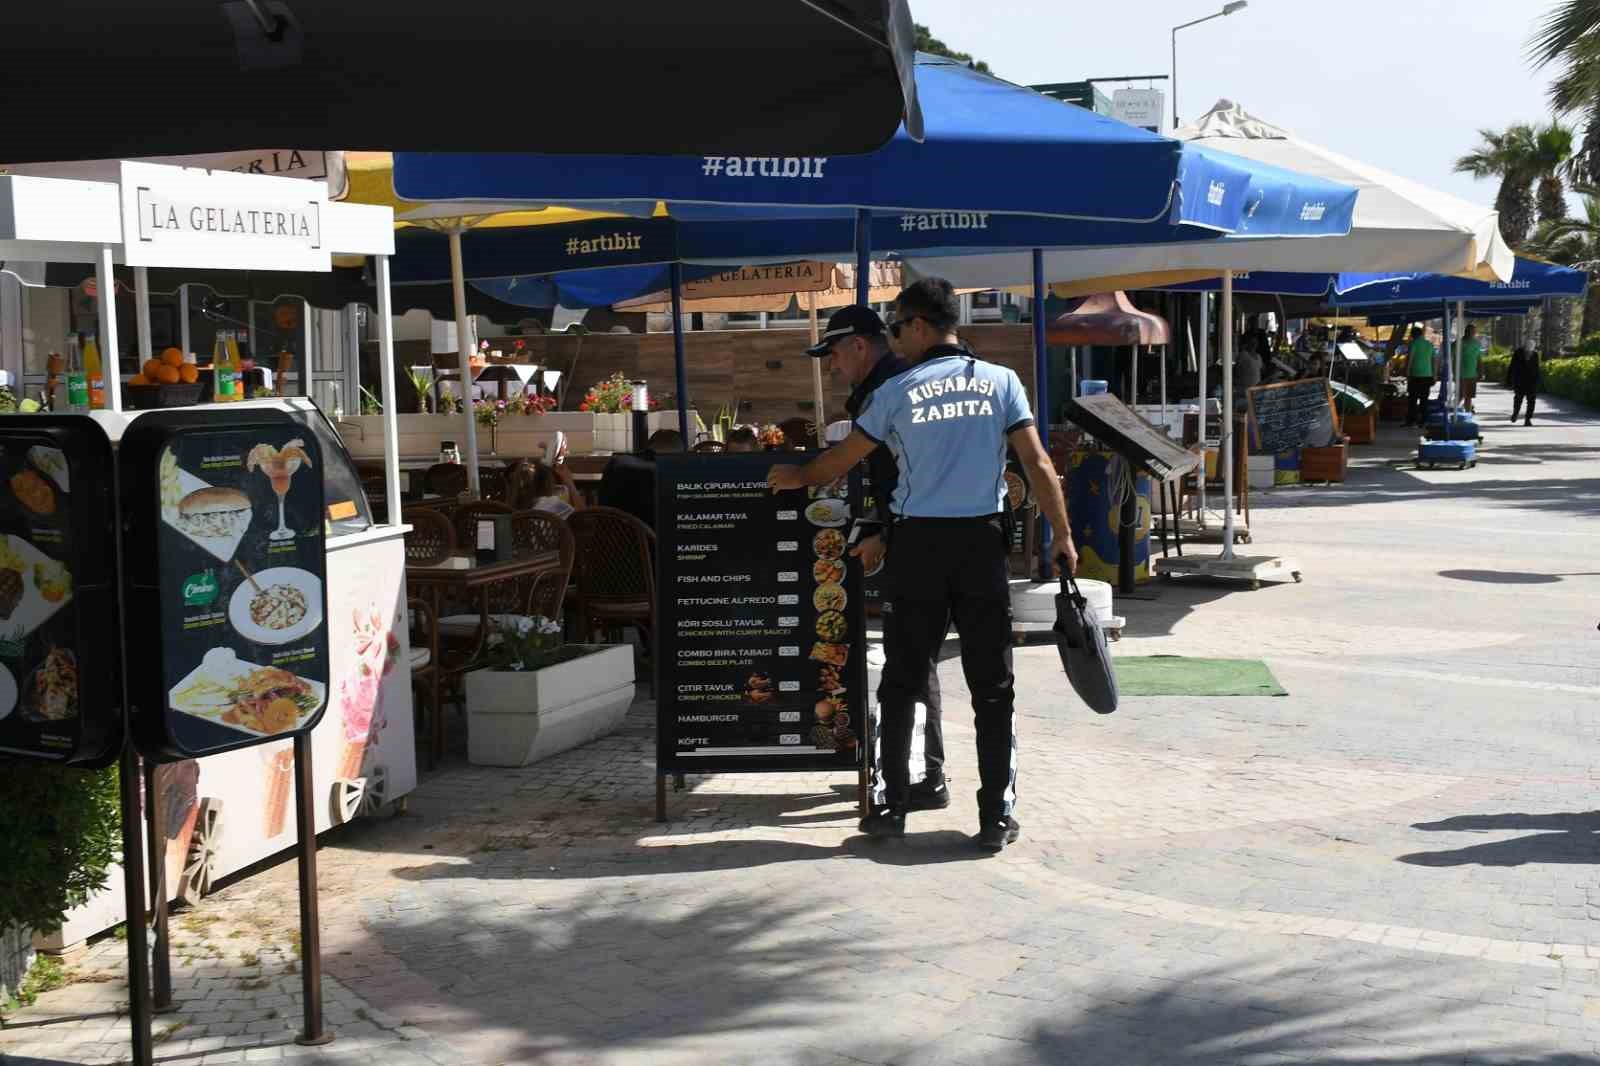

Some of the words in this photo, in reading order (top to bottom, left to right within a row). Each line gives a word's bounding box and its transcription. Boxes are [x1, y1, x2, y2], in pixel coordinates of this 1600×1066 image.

[151, 203, 180, 230] LA
[190, 206, 310, 237] GELATERIA
[912, 400, 993, 424] ZABITA
[677, 513, 723, 521] KALAMAR
[724, 512, 748, 520] TAVA
[677, 575, 699, 583] FISH
[700, 575, 721, 583] AND
[722, 574, 751, 582] CHIPS
[731, 596, 776, 604] ALFREDO
[705, 684, 735, 692] TAVUK
[677, 714, 739, 722] HAMBURGER
